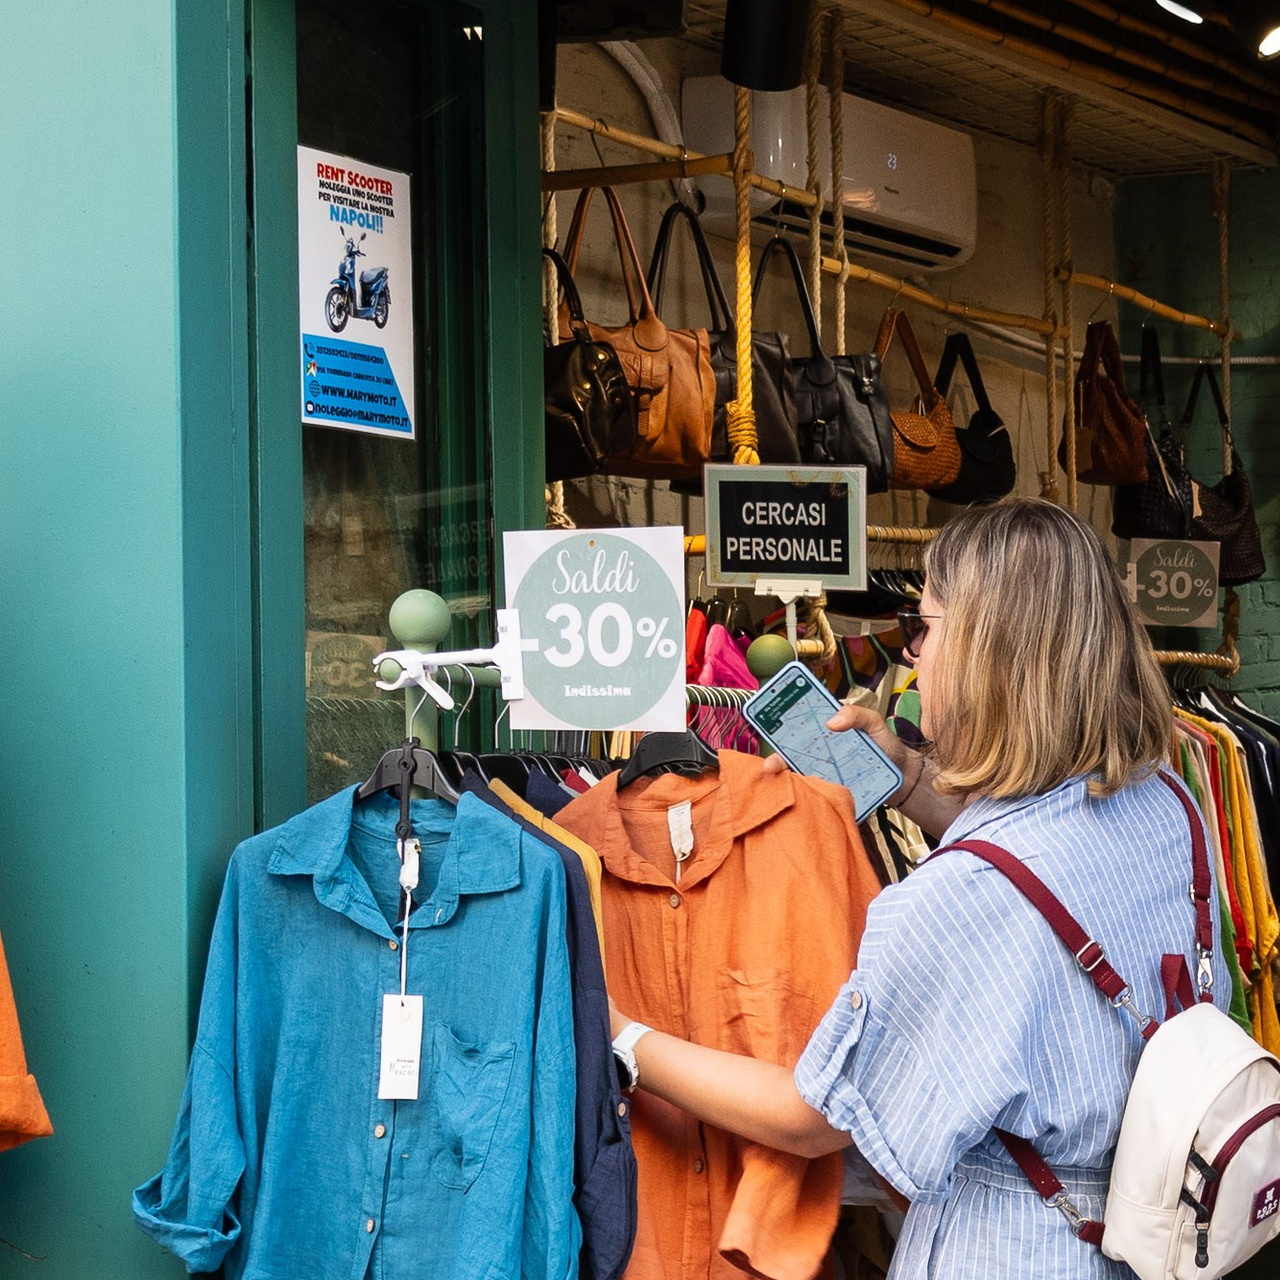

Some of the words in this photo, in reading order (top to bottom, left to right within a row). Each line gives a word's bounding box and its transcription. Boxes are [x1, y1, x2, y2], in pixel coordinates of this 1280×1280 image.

[887, 153, 897, 169] 23
[316, 163, 346, 183] RENT
[347, 171, 393, 196] SCOOTER
[318, 192, 331, 203] PER
[332, 194, 360, 209] VISITARE
[361, 202, 369, 212] LA
[369, 204, 395, 218] NOSTRA
[319, 180, 351, 195] NOLEGGIA
[352, 189, 366, 199] UNO
[366, 192, 394, 207] SCOOTER
[329, 205, 384, 234] NAPOLI!!
[741, 501, 826, 526] CERCASI
[726, 537, 843, 563] PERSONALE
[1153, 547, 1198, 568] Saldi
[552, 548, 640, 595] Saldi
[1136, 570, 1214, 600] -30%
[521, 602, 678, 668] -30%
[563, 684, 632, 698] Indissima
